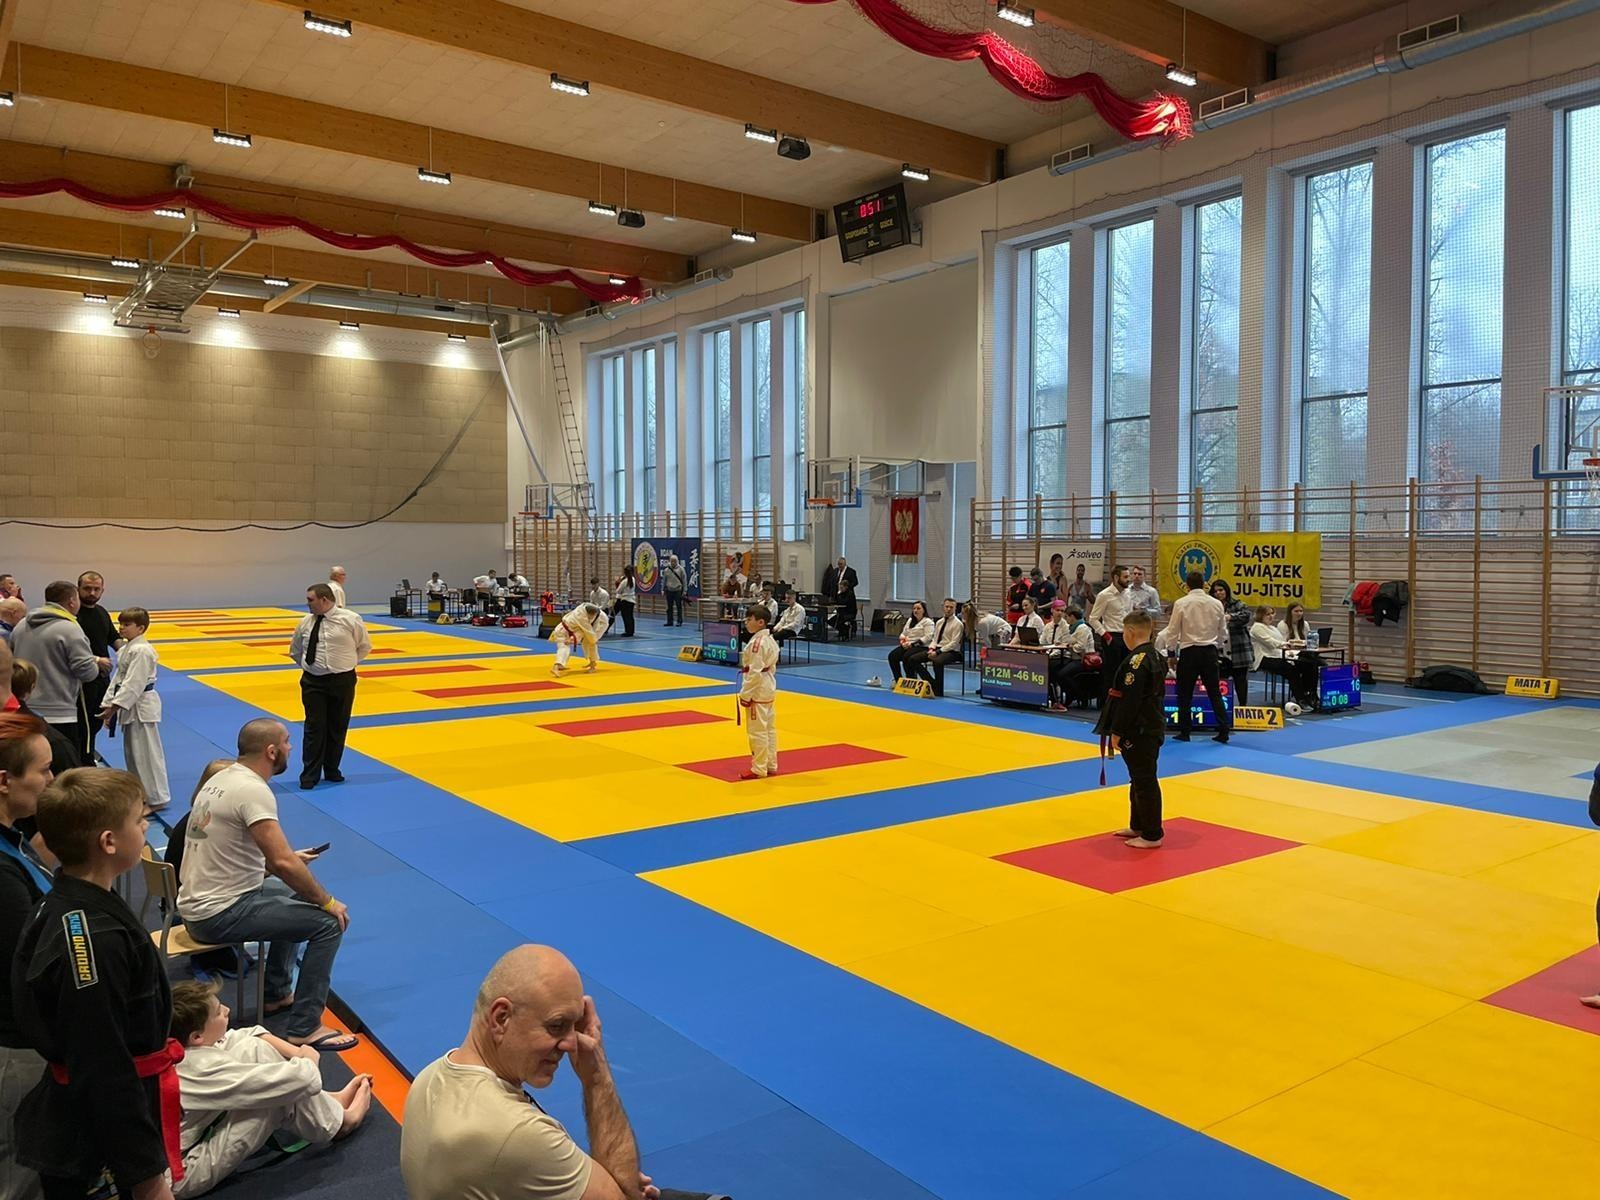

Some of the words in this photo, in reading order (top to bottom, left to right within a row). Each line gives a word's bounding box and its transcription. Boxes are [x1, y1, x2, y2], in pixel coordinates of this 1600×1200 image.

[1233, 541, 1286, 562] ŚLĄSKI
[1233, 564, 1303, 582] ZWIĄZEK
[1232, 583, 1303, 598] JU-JITSU
[985, 666, 1011, 679] F12M
[1013, 670, 1029, 681] -46
[1031, 671, 1045, 685] kg
[914, 681, 924, 695] 3
[1514, 678, 1540, 688] MATA
[1543, 680, 1551, 693] 1
[1234, 708, 1265, 720] MATA
[1266, 708, 1278, 725] 2
